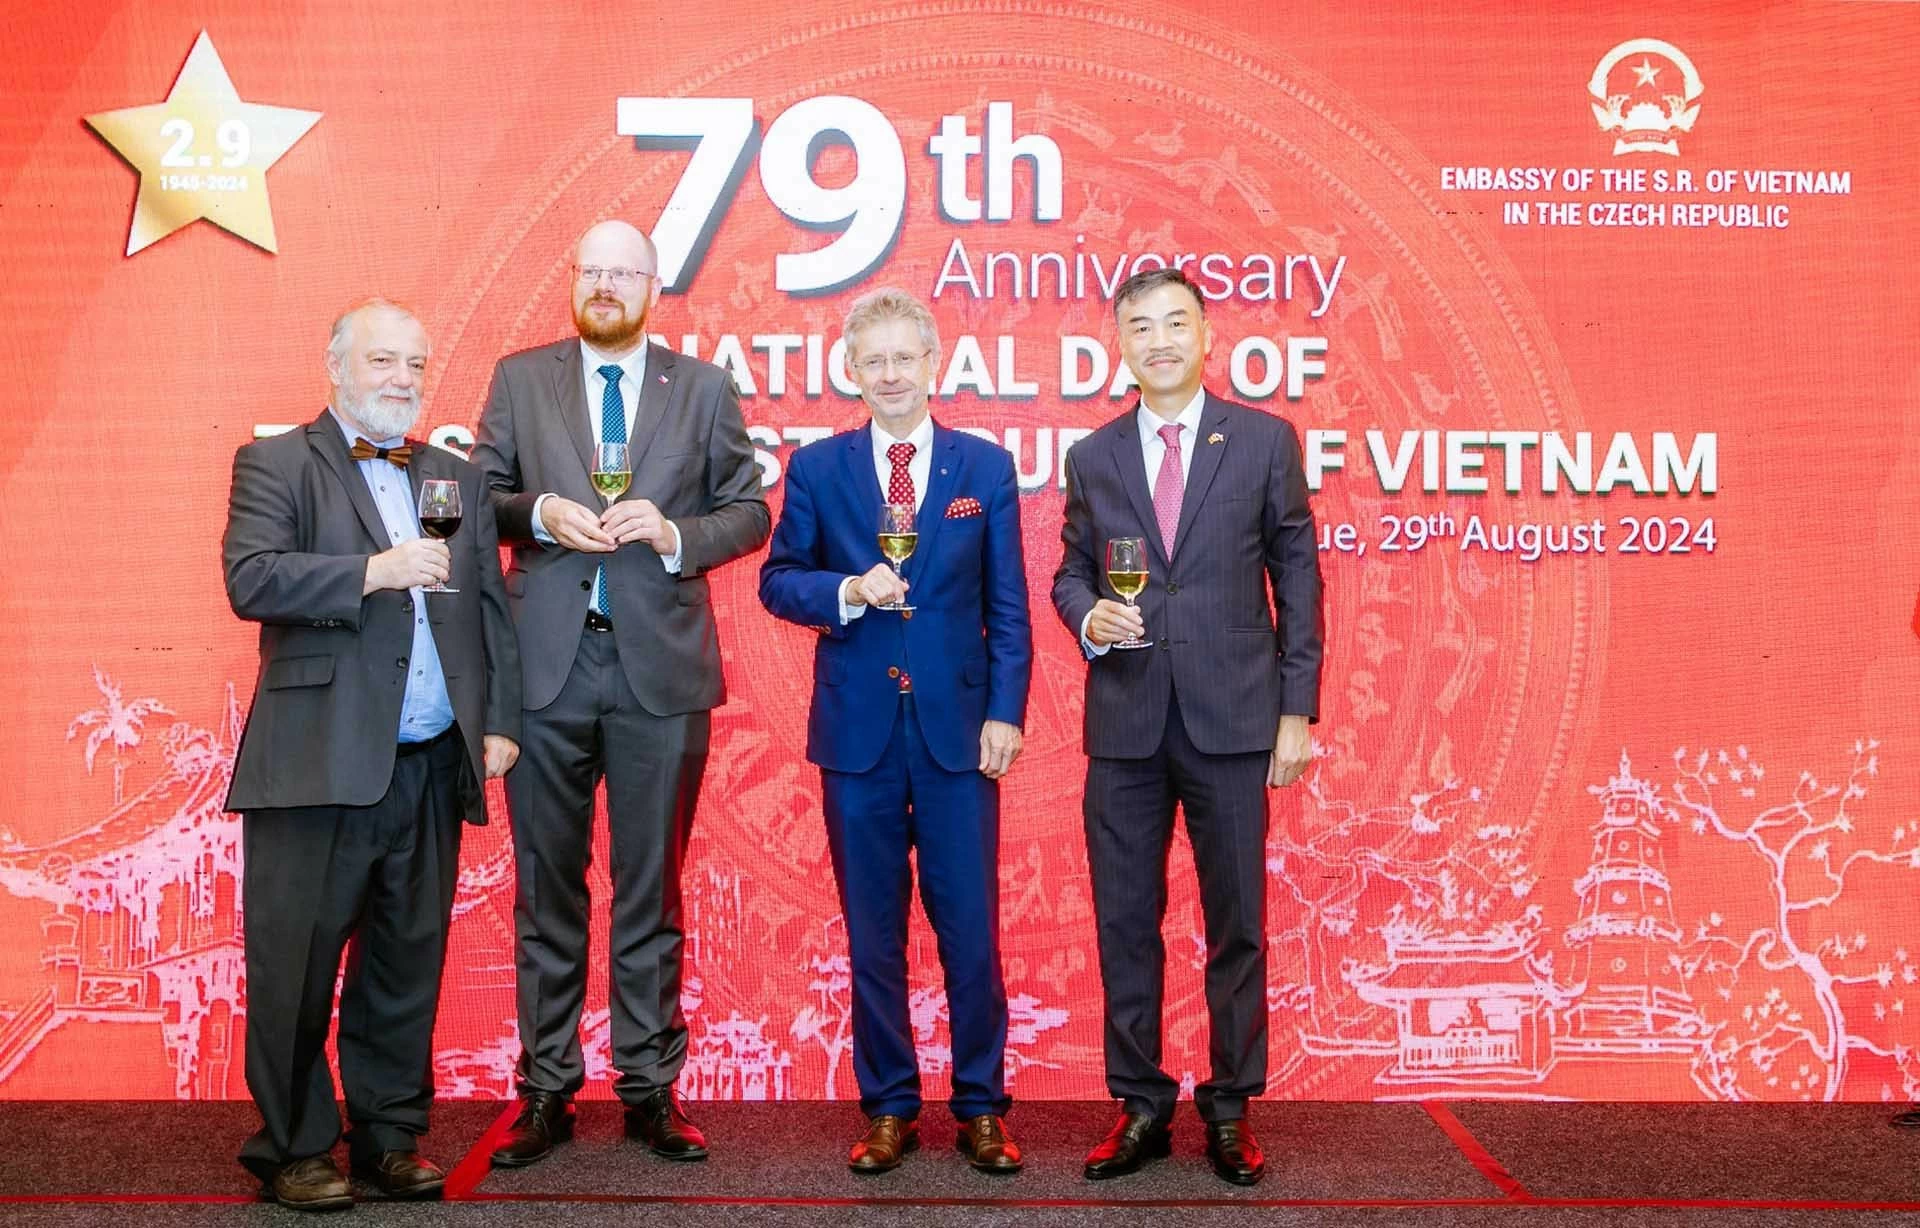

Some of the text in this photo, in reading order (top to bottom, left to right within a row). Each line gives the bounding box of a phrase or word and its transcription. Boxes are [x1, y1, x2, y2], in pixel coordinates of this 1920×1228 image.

[160, 118, 250, 168] 2.9
[1440, 167, 1852, 195] EMBASSY OF THE S.R. OF VIETNAM
[1503, 202, 1790, 229] IN THE CZECH REPUBLIC
[1229, 336, 1329, 398] OF
[1365, 430, 1718, 495] VIETNAM
[1378, 512, 1455, 553] 29th
[1460, 516, 1606, 562] August
[1618, 516, 1718, 555] 2024
